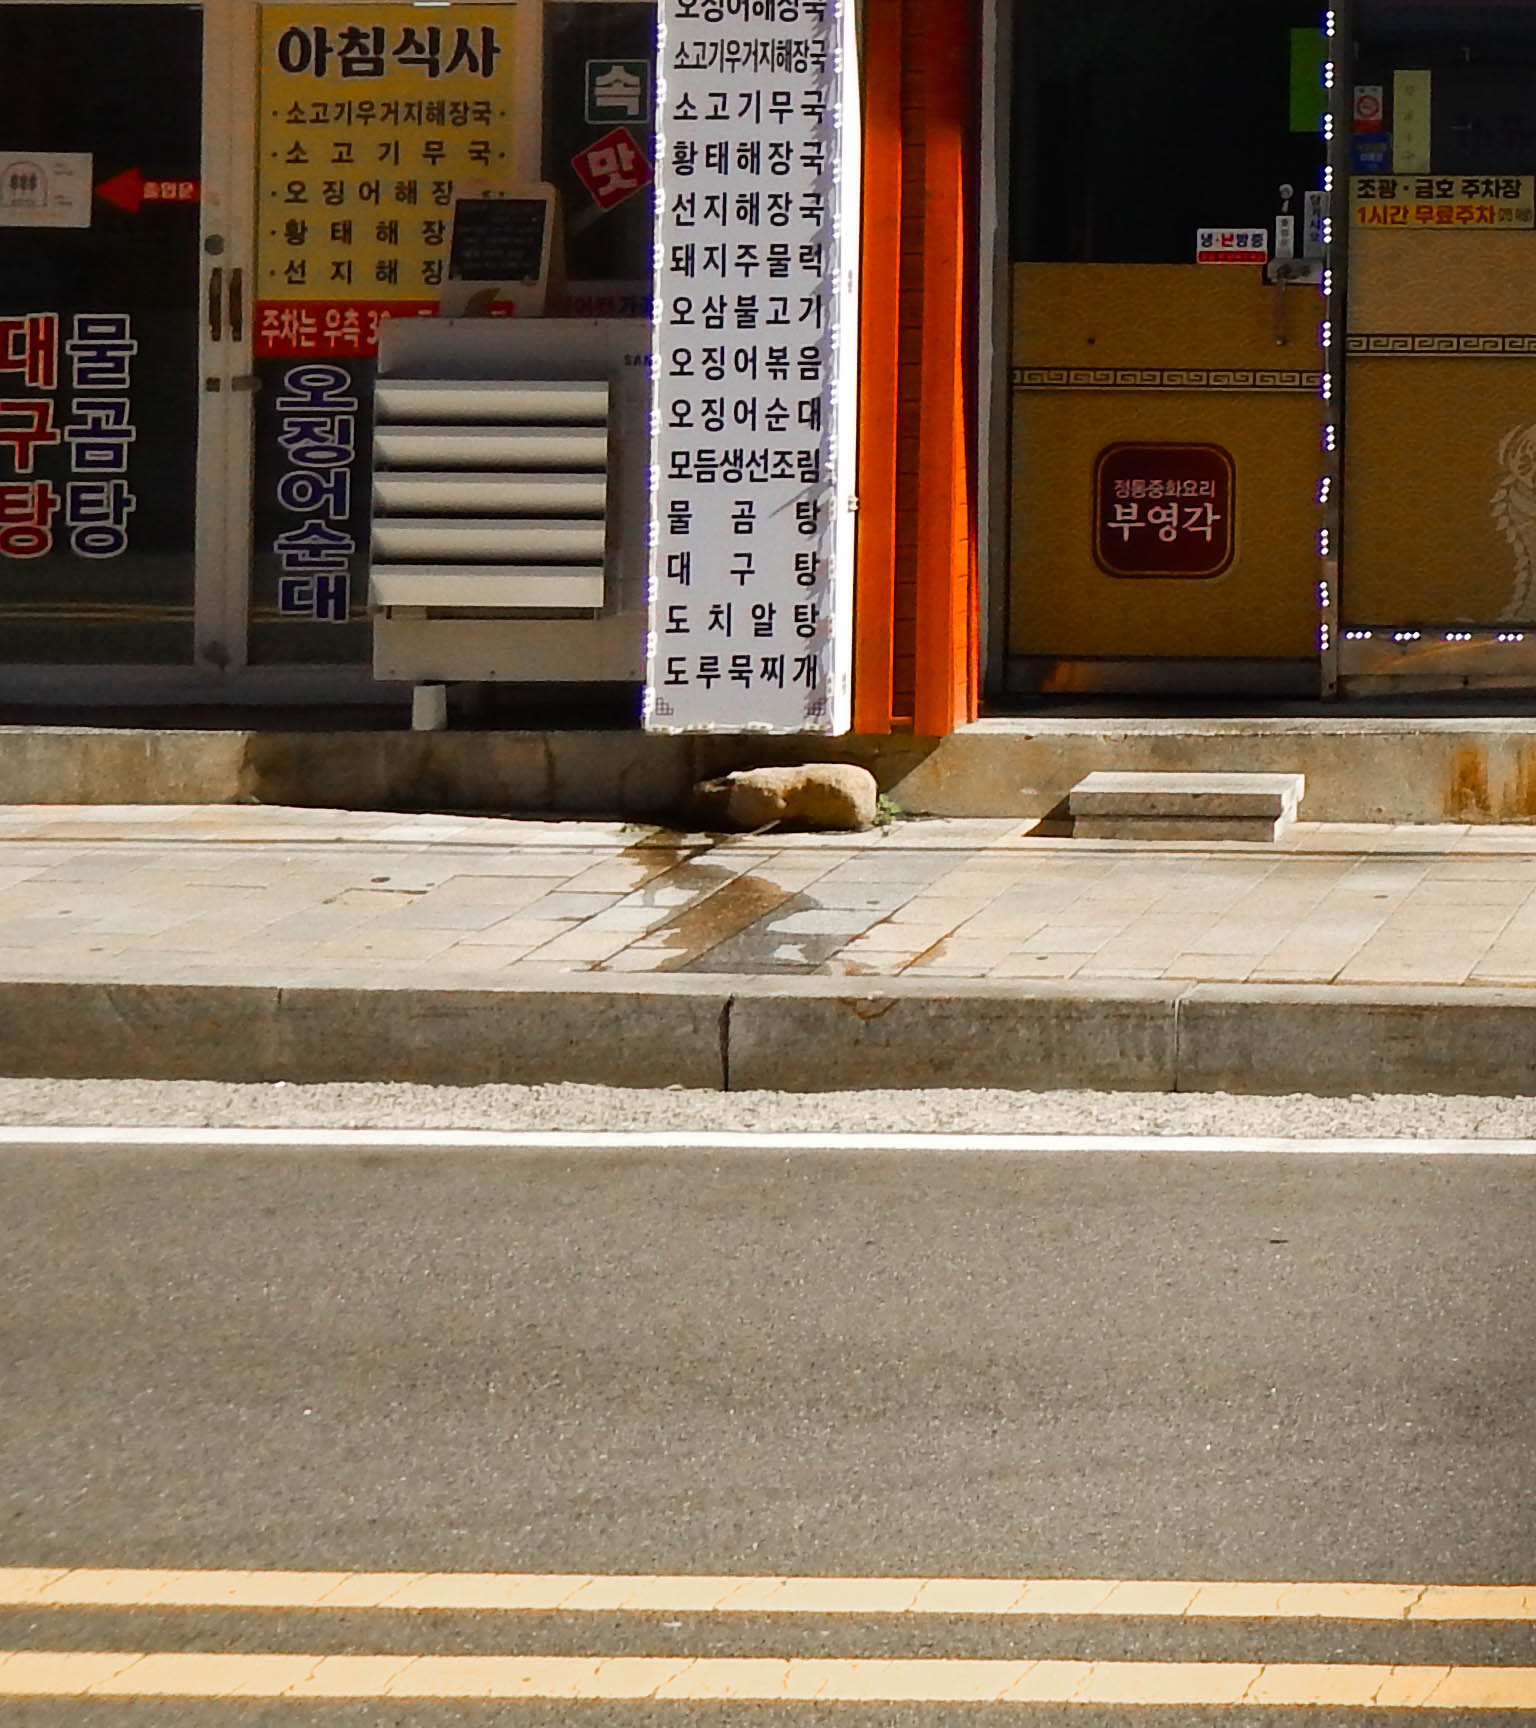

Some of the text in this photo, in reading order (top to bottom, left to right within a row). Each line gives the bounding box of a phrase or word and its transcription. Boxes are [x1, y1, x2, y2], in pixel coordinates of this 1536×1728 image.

[278, 26, 503, 77] 아침식사
[673, 38, 826, 74] 소고기우거지해장국
[285, 100, 494, 126] 소고기우거지해장국
[672, 89, 828, 124] 소고기무국
[671, 140, 825, 176] 황태해장국
[284, 180, 454, 206] 오징어해장
[1462, 177, 1523, 200] 주차장
[671, 191, 825, 227] 선지해장국
[284, 219, 445, 247] 황태해장
[284, 259, 442, 286] 선지해장
[669, 242, 822, 278] 돼지주물럭
[261, 308, 318, 349] 주차는
[669, 294, 822, 329] 오삼불고기
[668, 345, 822, 380] 오징어볶음
[668, 396, 822, 432] 오징어순대
[65, 313, 138, 559] 물곰탕
[667, 447, 821, 483] 모듬생선조림
[274, 364, 358, 623] 오징어순대
[1106, 502, 1222, 543] 부영각
